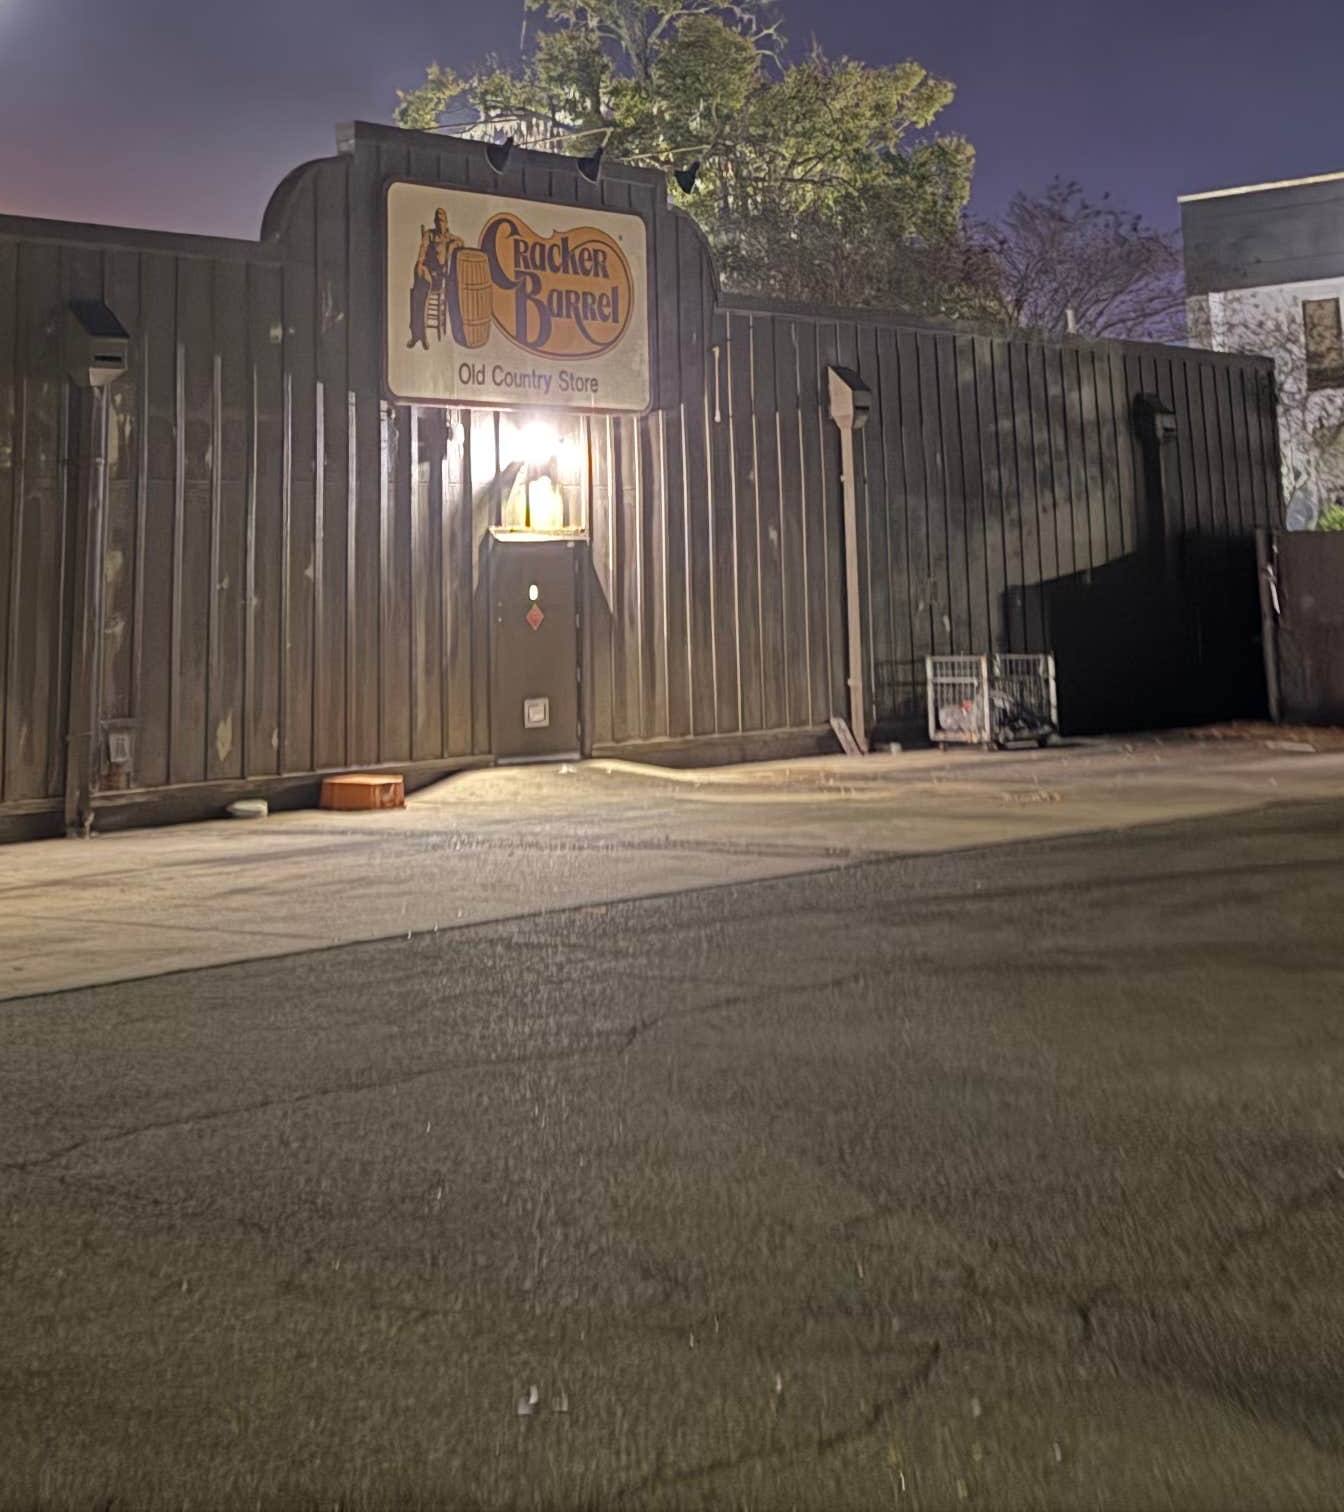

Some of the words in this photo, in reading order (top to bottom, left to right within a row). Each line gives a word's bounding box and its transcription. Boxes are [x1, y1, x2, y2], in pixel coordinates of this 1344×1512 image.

[459, 363, 485, 385] Old
[492, 365, 552, 394] Country
[559, 371, 599, 393] Store
